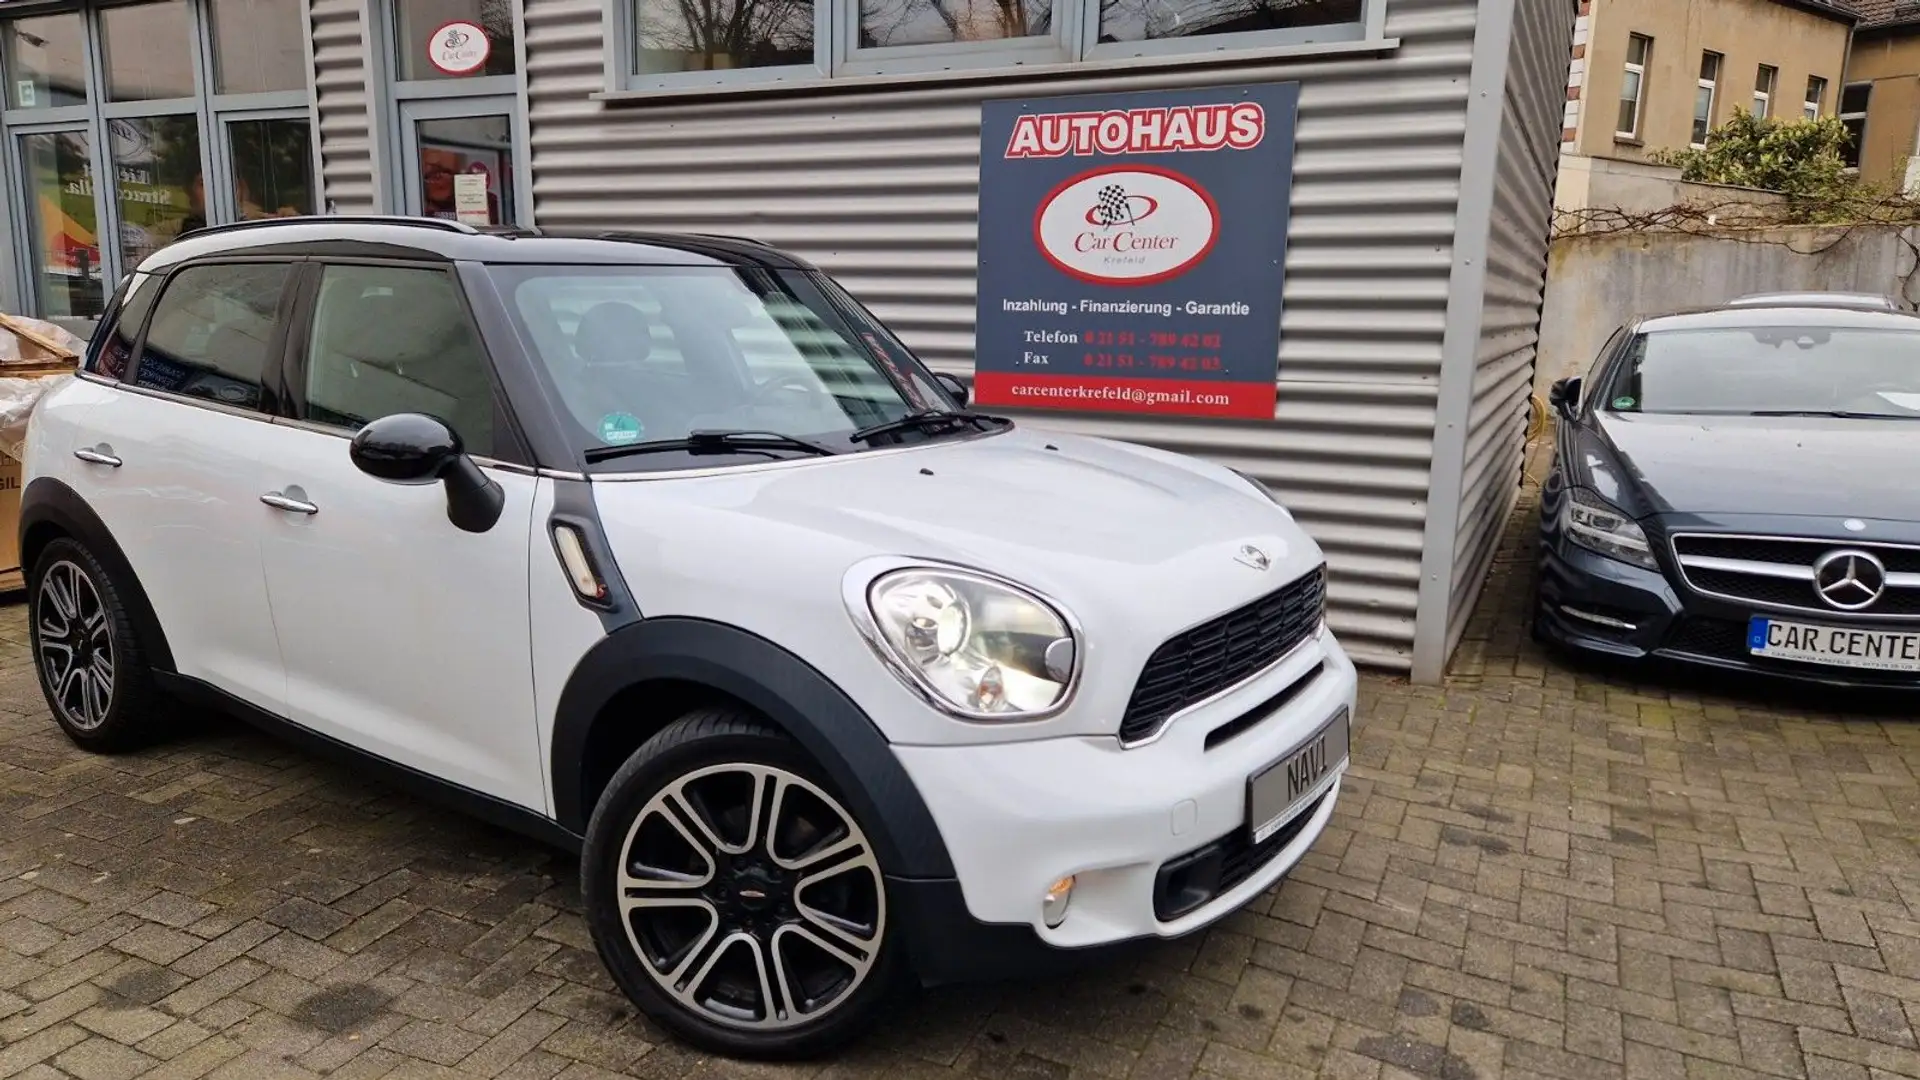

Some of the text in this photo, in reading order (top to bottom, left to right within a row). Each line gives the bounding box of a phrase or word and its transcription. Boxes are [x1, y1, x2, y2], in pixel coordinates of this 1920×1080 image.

[1004, 102, 1264, 158] AUTOHAUS
[1103, 256, 1146, 265] Krefeld
[1003, 299, 1067, 315] Inzahlung
[1080, 300, 1172, 317] Finanzierung
[1186, 301, 1250, 316] Garantie
[1024, 330, 1078, 345] Telefon
[1023, 352, 1049, 365] Fax
[1012, 384, 1230, 406] carcenterkrefeld@gmail.com
[1767, 623, 1920, 661] CAR.CENTE
